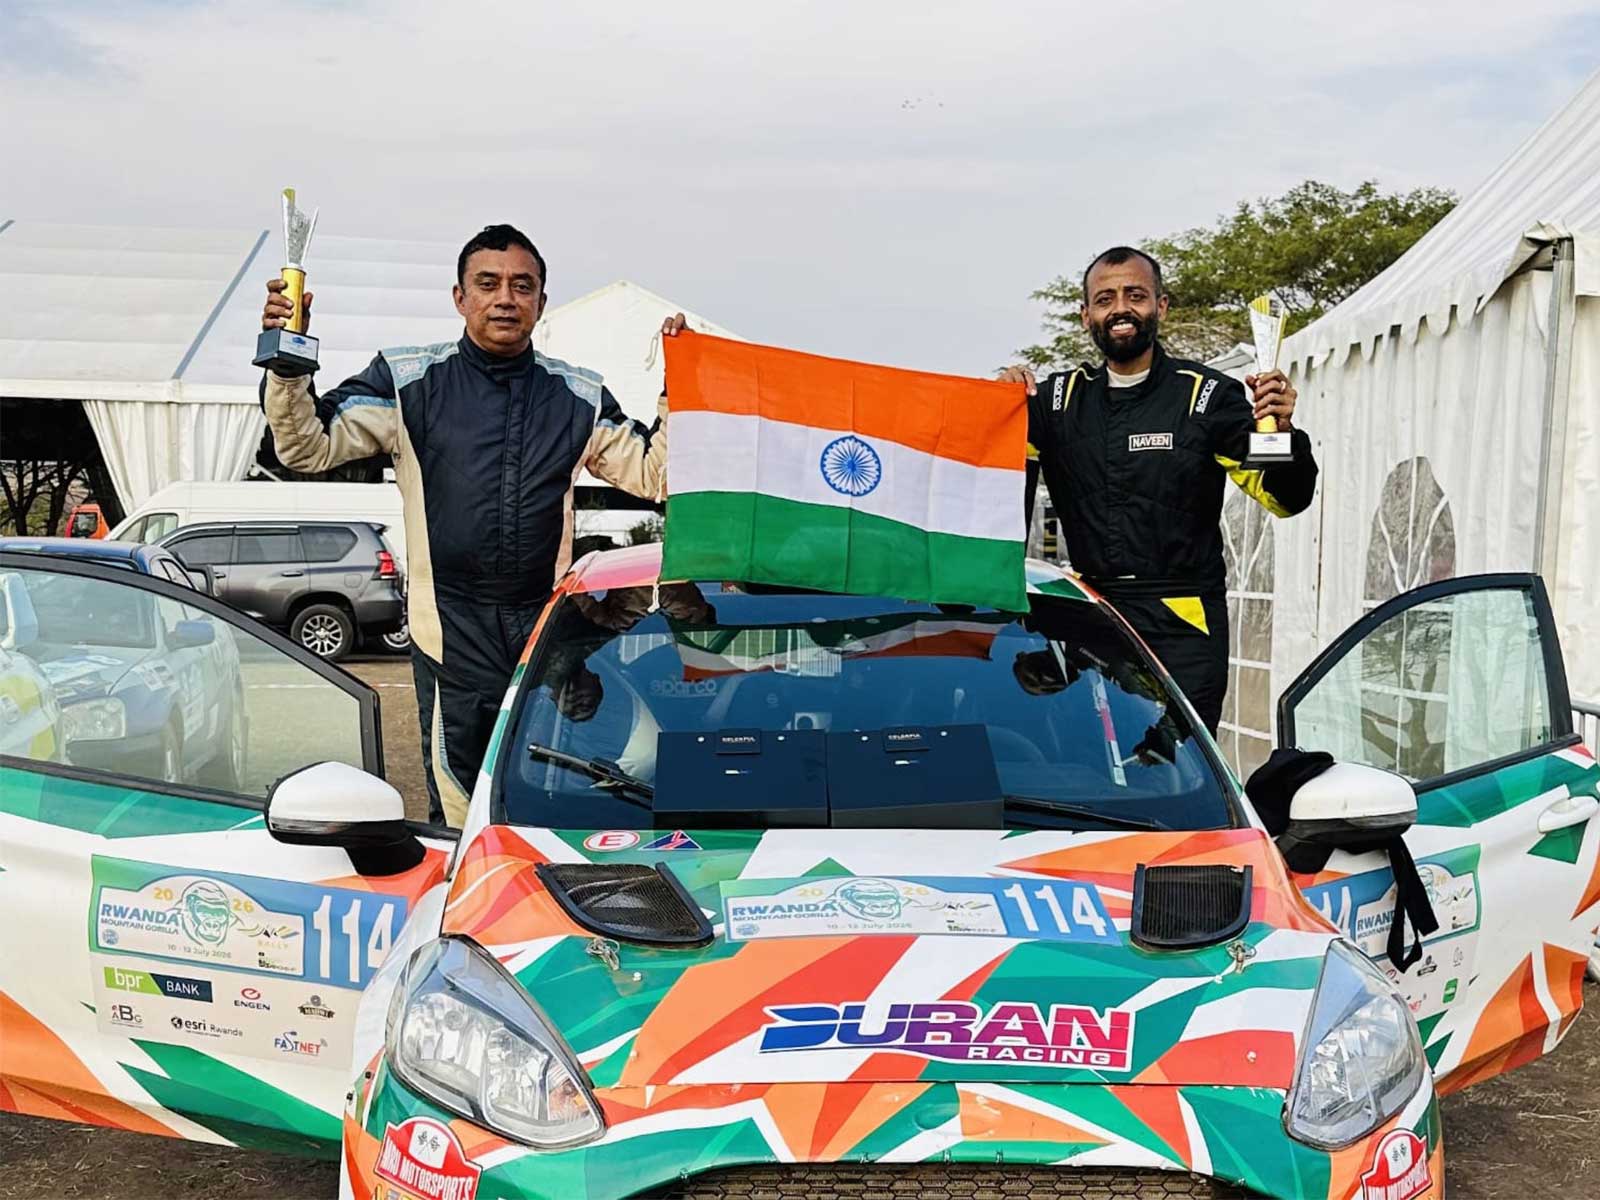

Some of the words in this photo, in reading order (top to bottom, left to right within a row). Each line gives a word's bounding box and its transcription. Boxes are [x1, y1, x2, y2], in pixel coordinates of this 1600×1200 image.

[1195, 379, 1218, 414] sparco
[1133, 436, 1170, 448] NAVEEN
[649, 679, 716, 697] sparco
[600, 834, 624, 846] E
[154, 887, 173, 900] 20
[233, 898, 254, 913] 26
[797, 888, 823, 896] 20
[903, 887, 930, 896] 26
[101, 903, 179, 926] RWANDA
[732, 903, 838, 916] RWANDA
[1003, 882, 1107, 936] 114
[101, 917, 144, 930] MOUNTAIN
[145, 924, 179, 935] GORILLA
[1357, 910, 1396, 931] RWAN
[314, 895, 395, 983] 114
[114, 967, 144, 992] bpr
[166, 981, 200, 996] BANK
[234, 1000, 271, 1011] ENGEN
[184, 1019, 206, 1031] esri
[209, 1024, 243, 1037] Rwanda
[760, 1003, 1131, 1051] DURAN
[274, 1032, 321, 1054] FASTNET
[967, 1046, 1112, 1066] RACING
[399, 1156, 474, 1200] MOTORSPORTS
